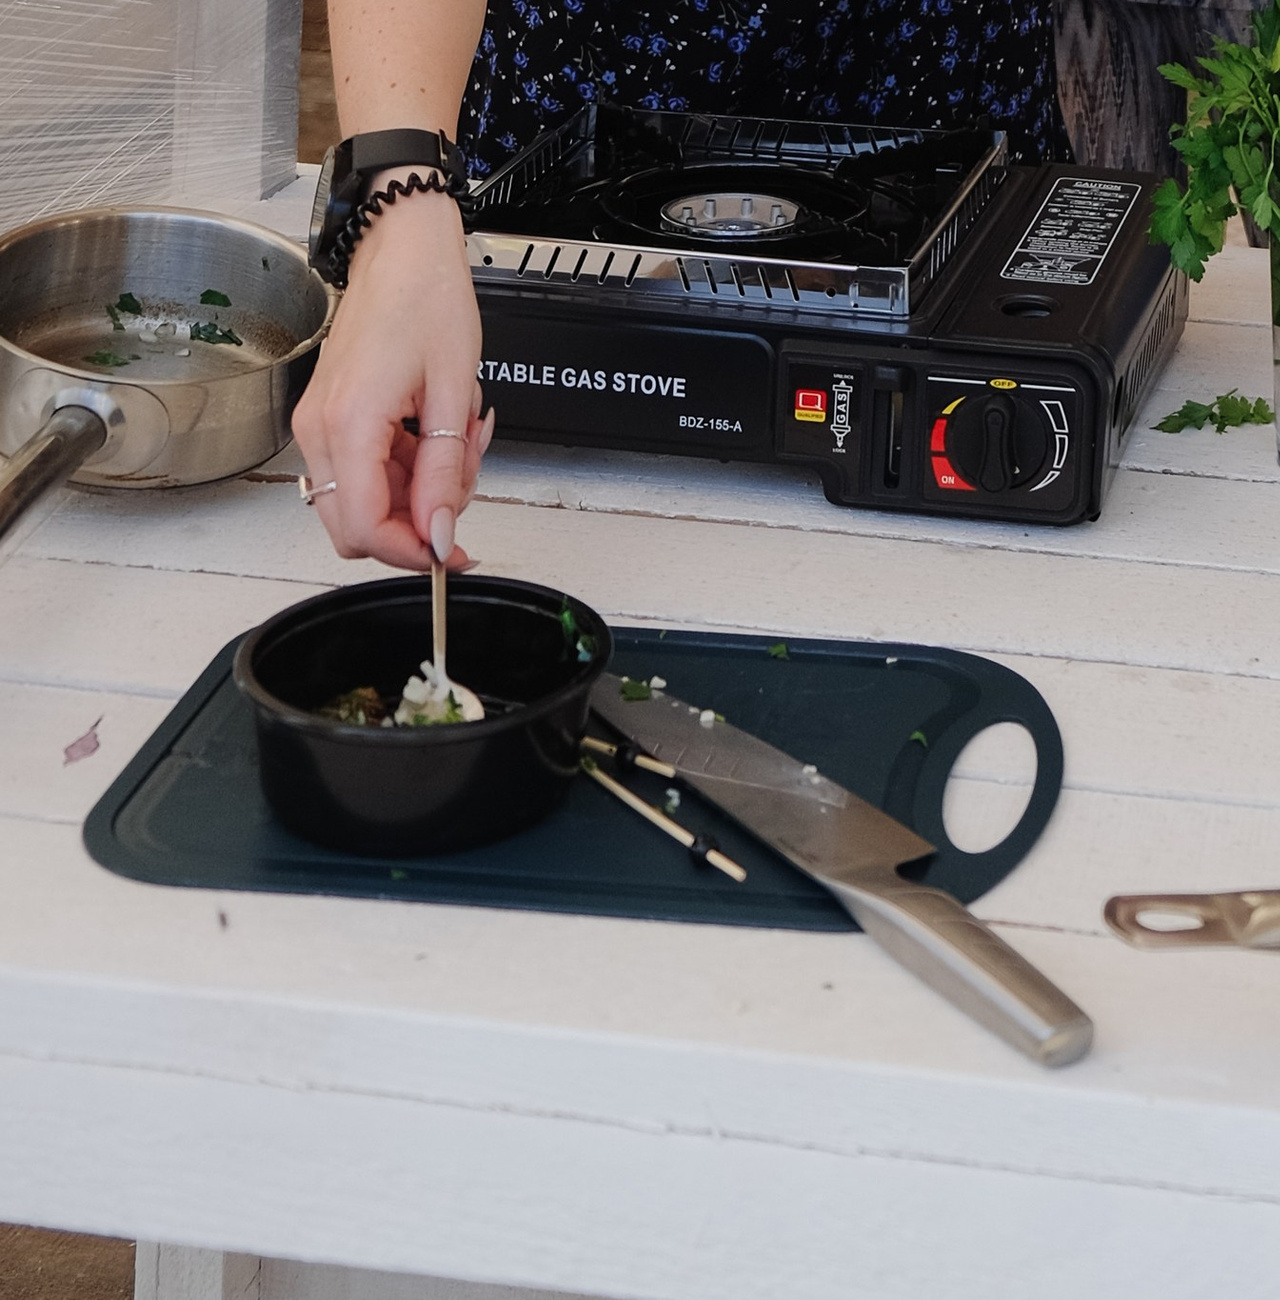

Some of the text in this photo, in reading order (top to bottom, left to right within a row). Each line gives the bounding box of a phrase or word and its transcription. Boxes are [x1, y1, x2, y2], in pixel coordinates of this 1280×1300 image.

[1072, 181, 1121, 191] CAUTION
[477, 360, 686, 398] RTABLE GAS STOVE
[993, 380, 1014, 388] OFF
[836, 393, 847, 423] GAS
[679, 415, 742, 432] BDZ-155-A
[941, 475, 955, 484] ON
